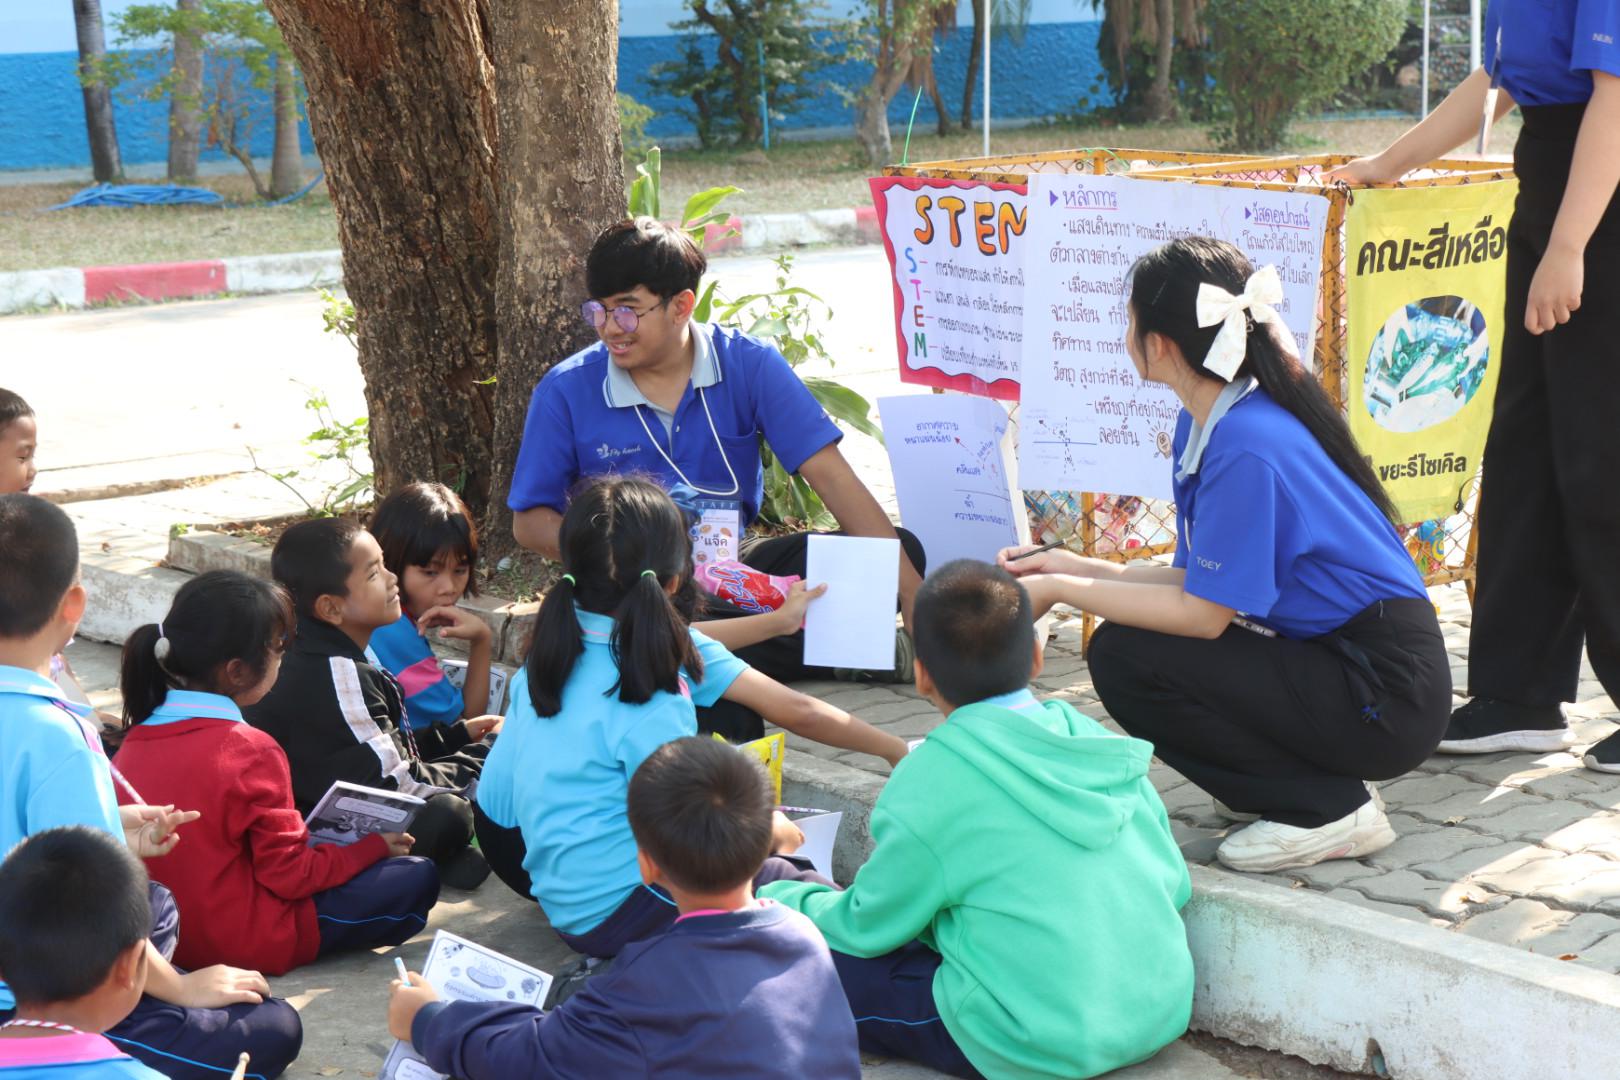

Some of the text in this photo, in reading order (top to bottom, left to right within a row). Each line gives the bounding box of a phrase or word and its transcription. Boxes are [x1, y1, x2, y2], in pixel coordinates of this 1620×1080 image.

[1063, 184, 1118, 208] หลักการ
[1379, 452, 1467, 482] ขยะรีไซเคิล
[1196, 556, 1221, 571] TOEY
